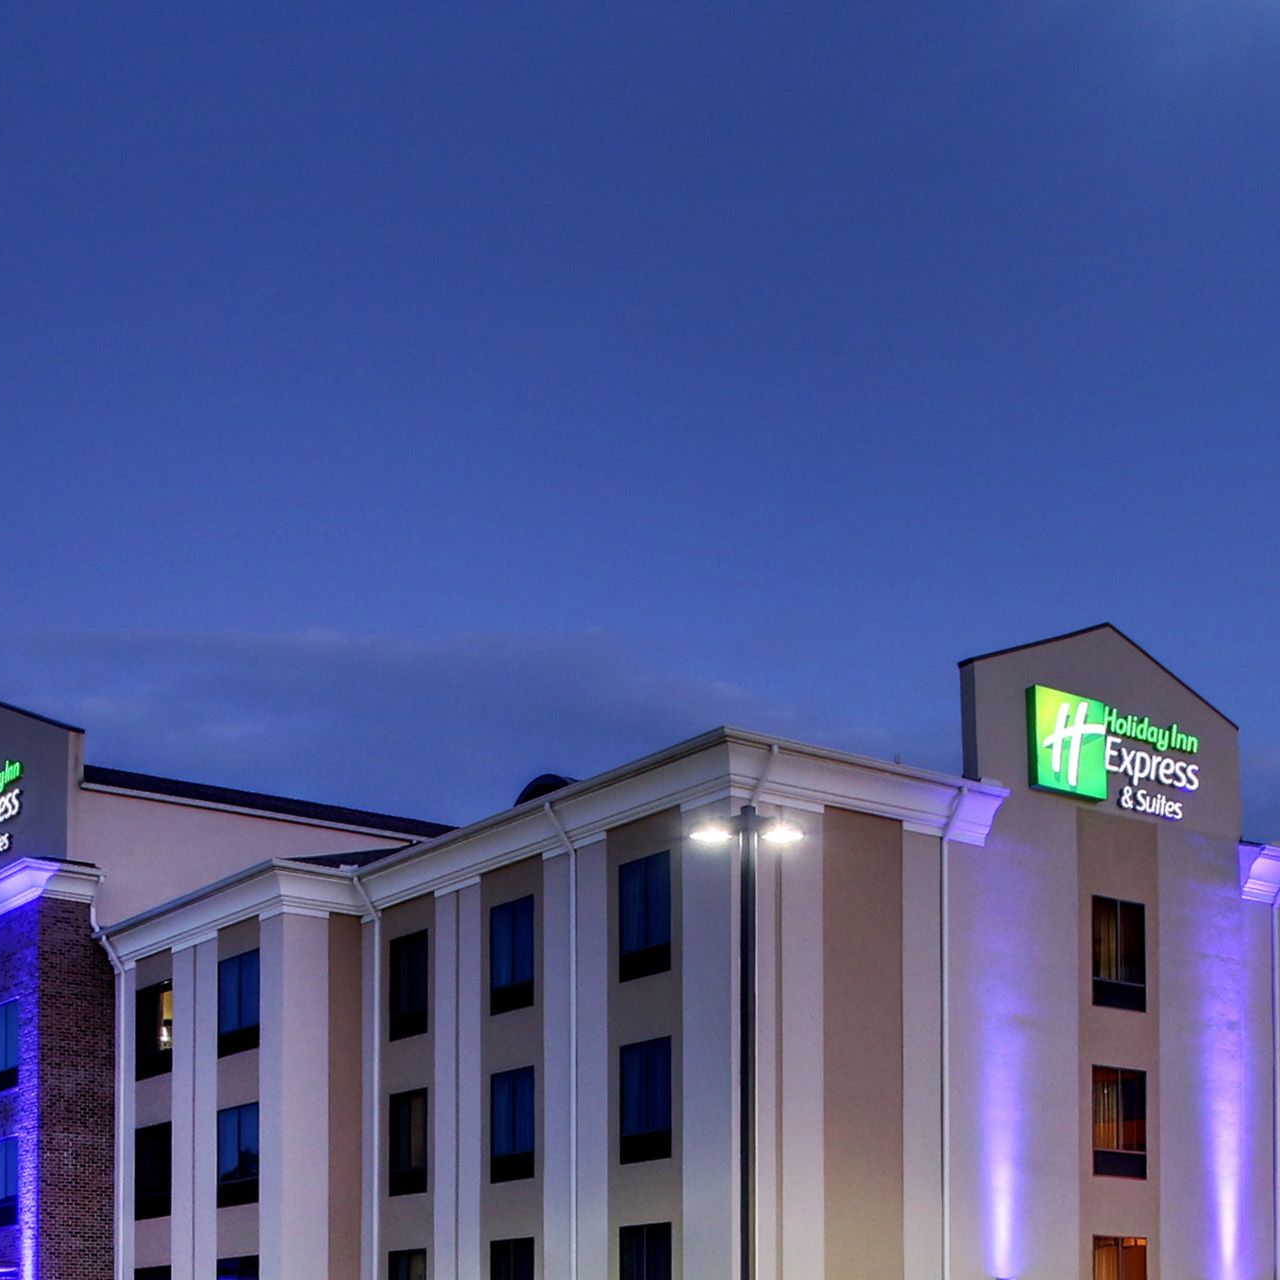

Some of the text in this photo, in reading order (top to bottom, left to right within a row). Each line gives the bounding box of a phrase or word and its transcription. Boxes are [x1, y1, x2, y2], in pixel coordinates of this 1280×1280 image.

[1105, 706, 1199, 754] Holiday Inn
[4, 760, 20, 784] Inn
[1104, 735, 1200, 791] Express
[1121, 786, 1183, 820] & Suites
